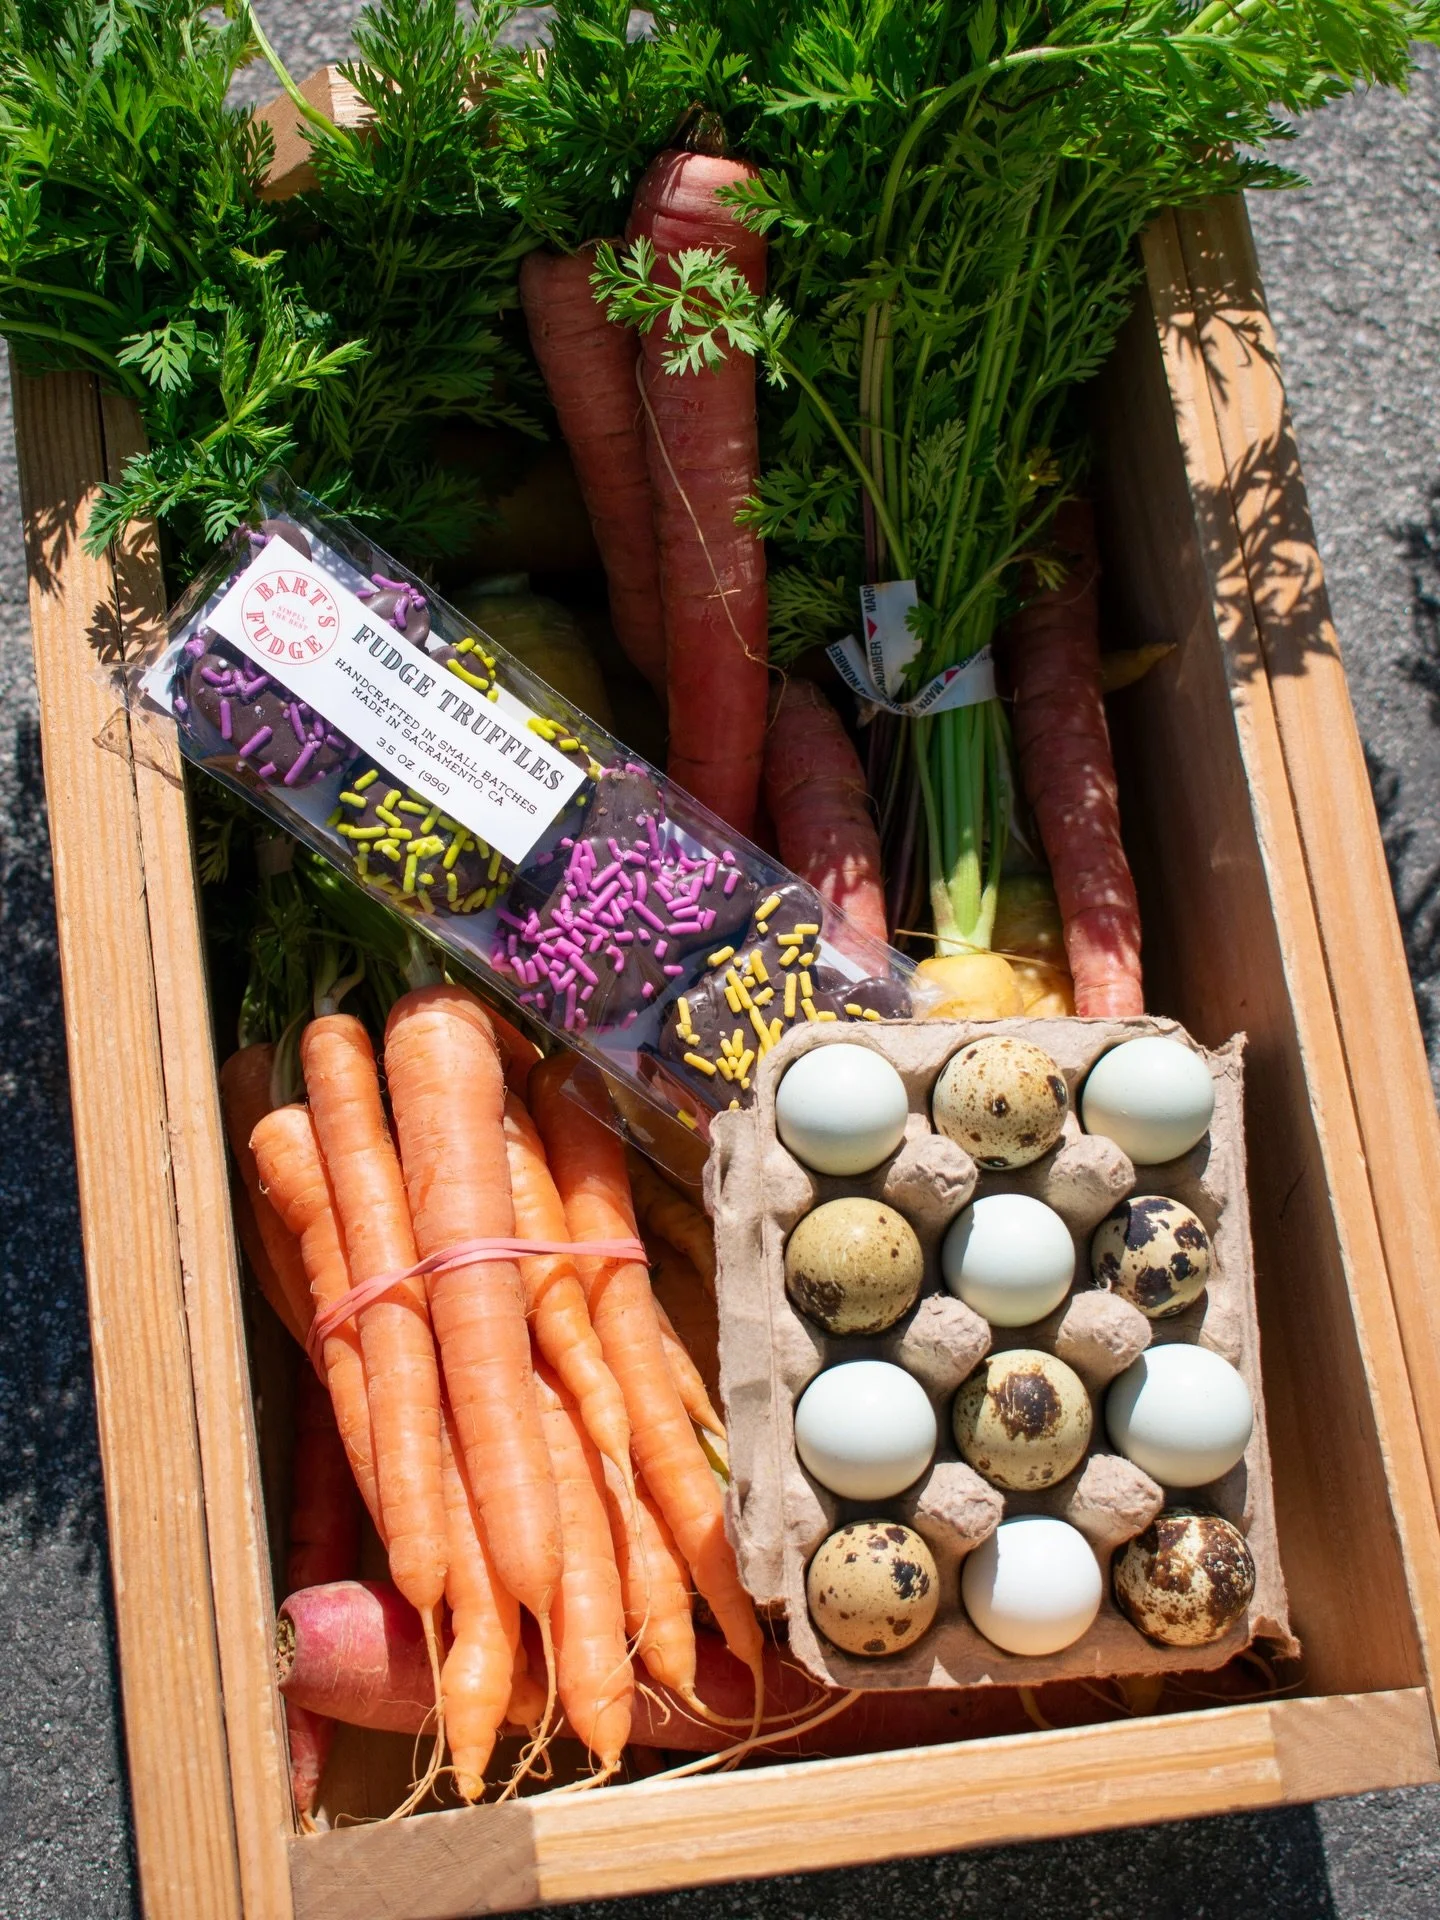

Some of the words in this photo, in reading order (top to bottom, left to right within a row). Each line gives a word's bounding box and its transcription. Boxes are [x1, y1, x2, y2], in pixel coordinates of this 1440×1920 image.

[255, 576, 336, 628] BART'S
[246, 611, 323, 659] FUDGE
[870, 641, 887, 687] NUMBER
[335, 658, 420, 729] HANDCRAFTED
[421, 728, 437, 741] IN
[438, 740, 477, 773] SMALL
[481, 770, 538, 814] BATCHES
[352, 624, 437, 697] FUDGE
[437, 689, 565, 789] TRUFFLES
[352, 686, 386, 717] MADE
[385, 715, 401, 729] IN
[401, 728, 484, 792] SACRAMENTO,
[488, 791, 504, 807] CA
[376, 736, 397, 755] 3.5
[418, 770, 450, 795] (99G)
